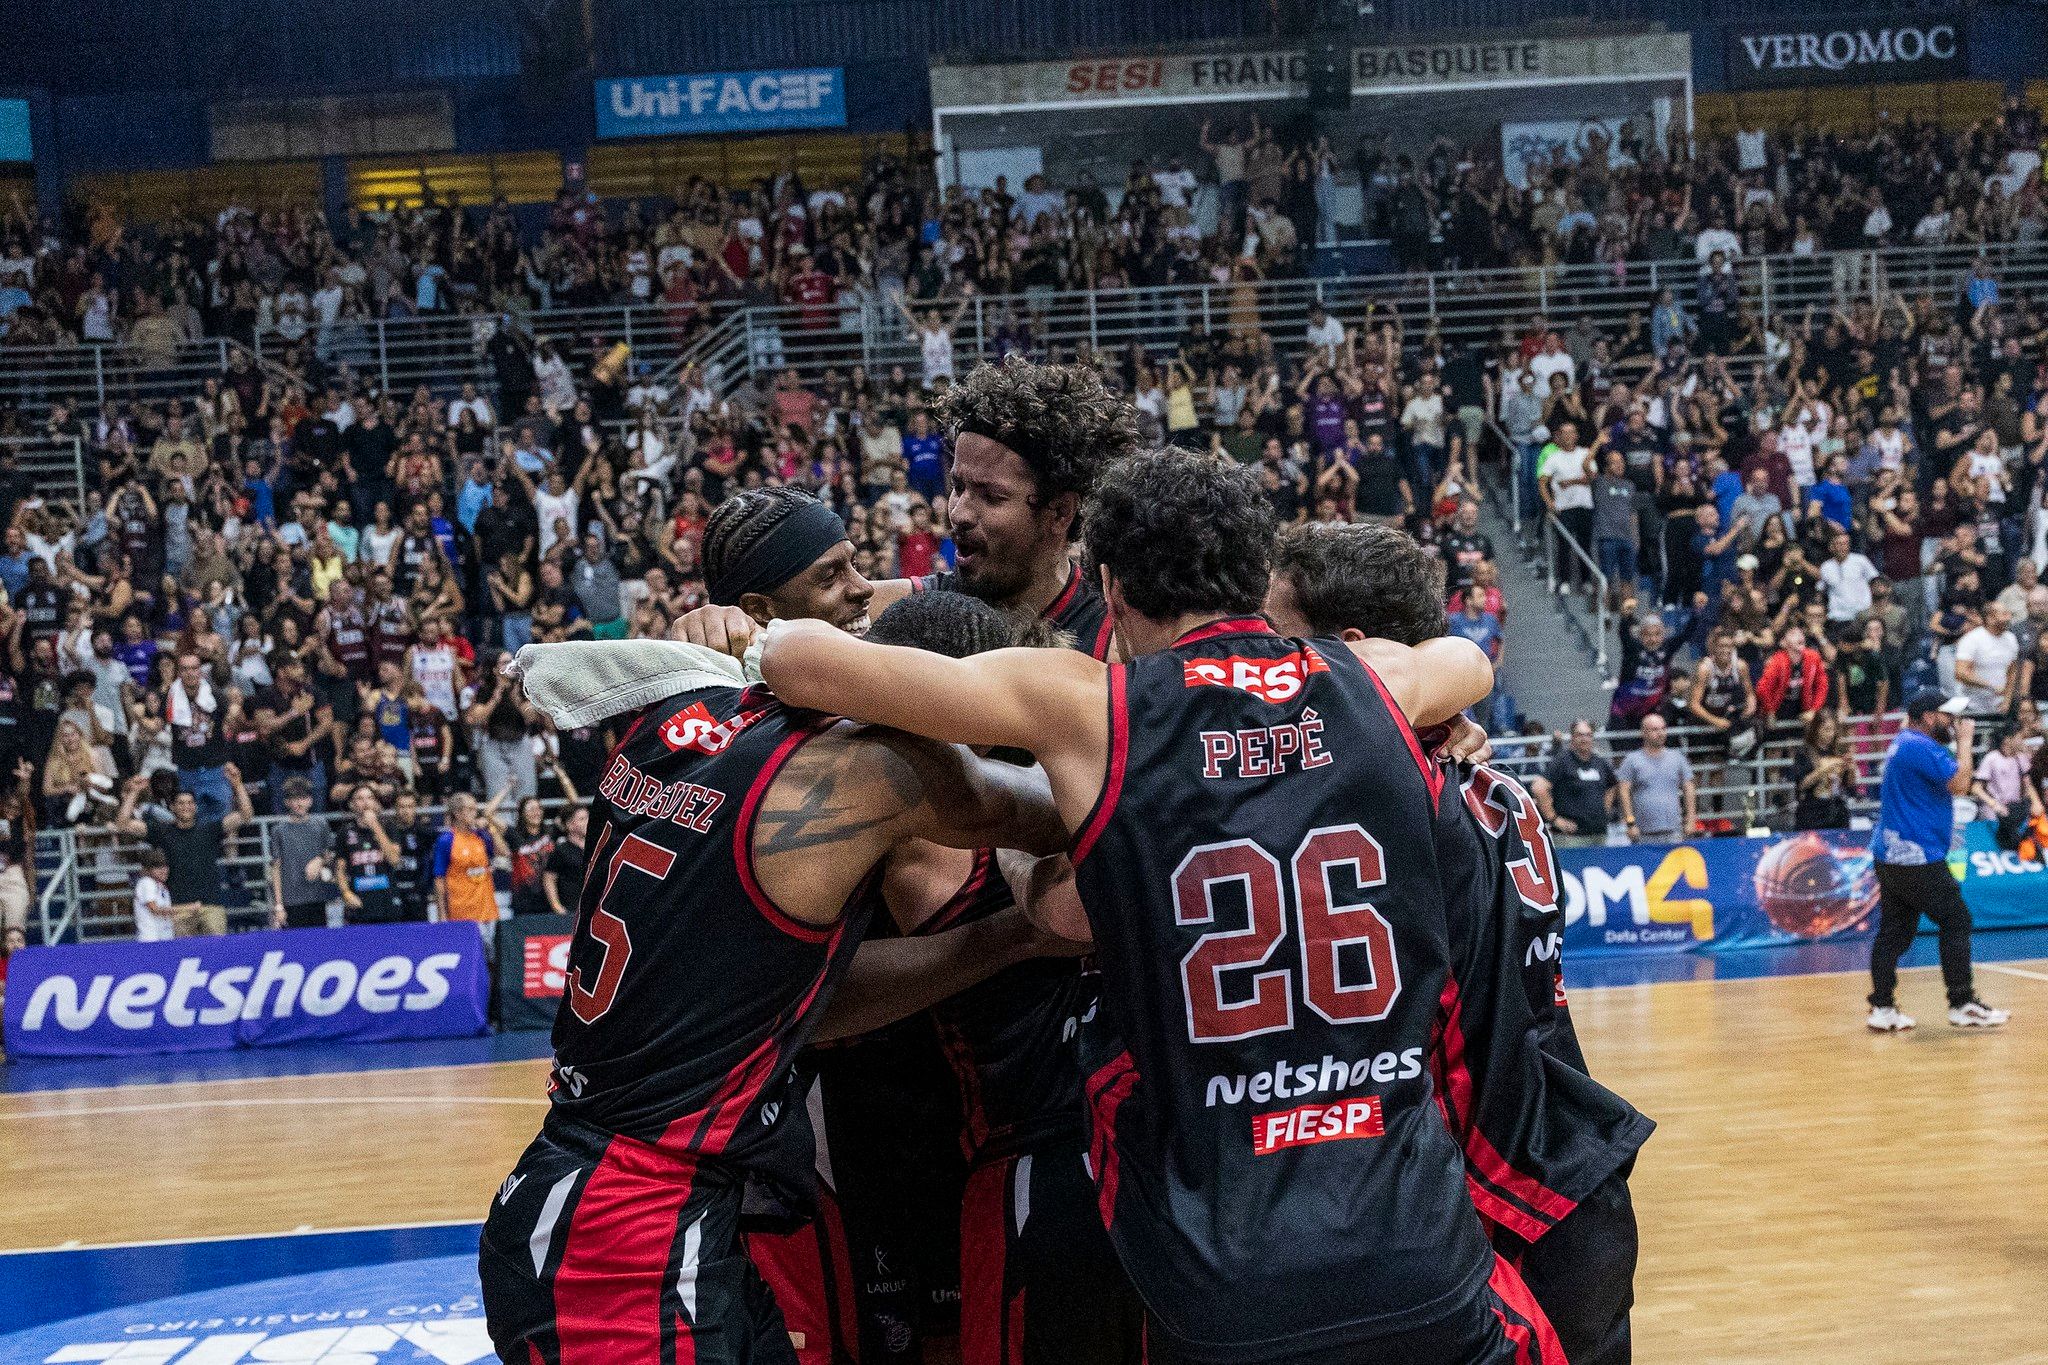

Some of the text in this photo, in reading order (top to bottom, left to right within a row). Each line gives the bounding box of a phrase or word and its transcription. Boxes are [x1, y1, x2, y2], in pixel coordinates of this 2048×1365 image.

[1067, 46, 1540, 93] SESI FRANC BASQUETE
[1741, 25, 1957, 70] VEROMOC
[1194, 661, 1308, 701] SES
[1199, 706, 1334, 778] PEPÊ
[1170, 822, 1403, 1044] 26
[1605, 928, 1687, 943] Data Center
[1265, 1103, 1371, 1149] FIESP
[123, 1308, 369, 1335] BRASILEIRO
